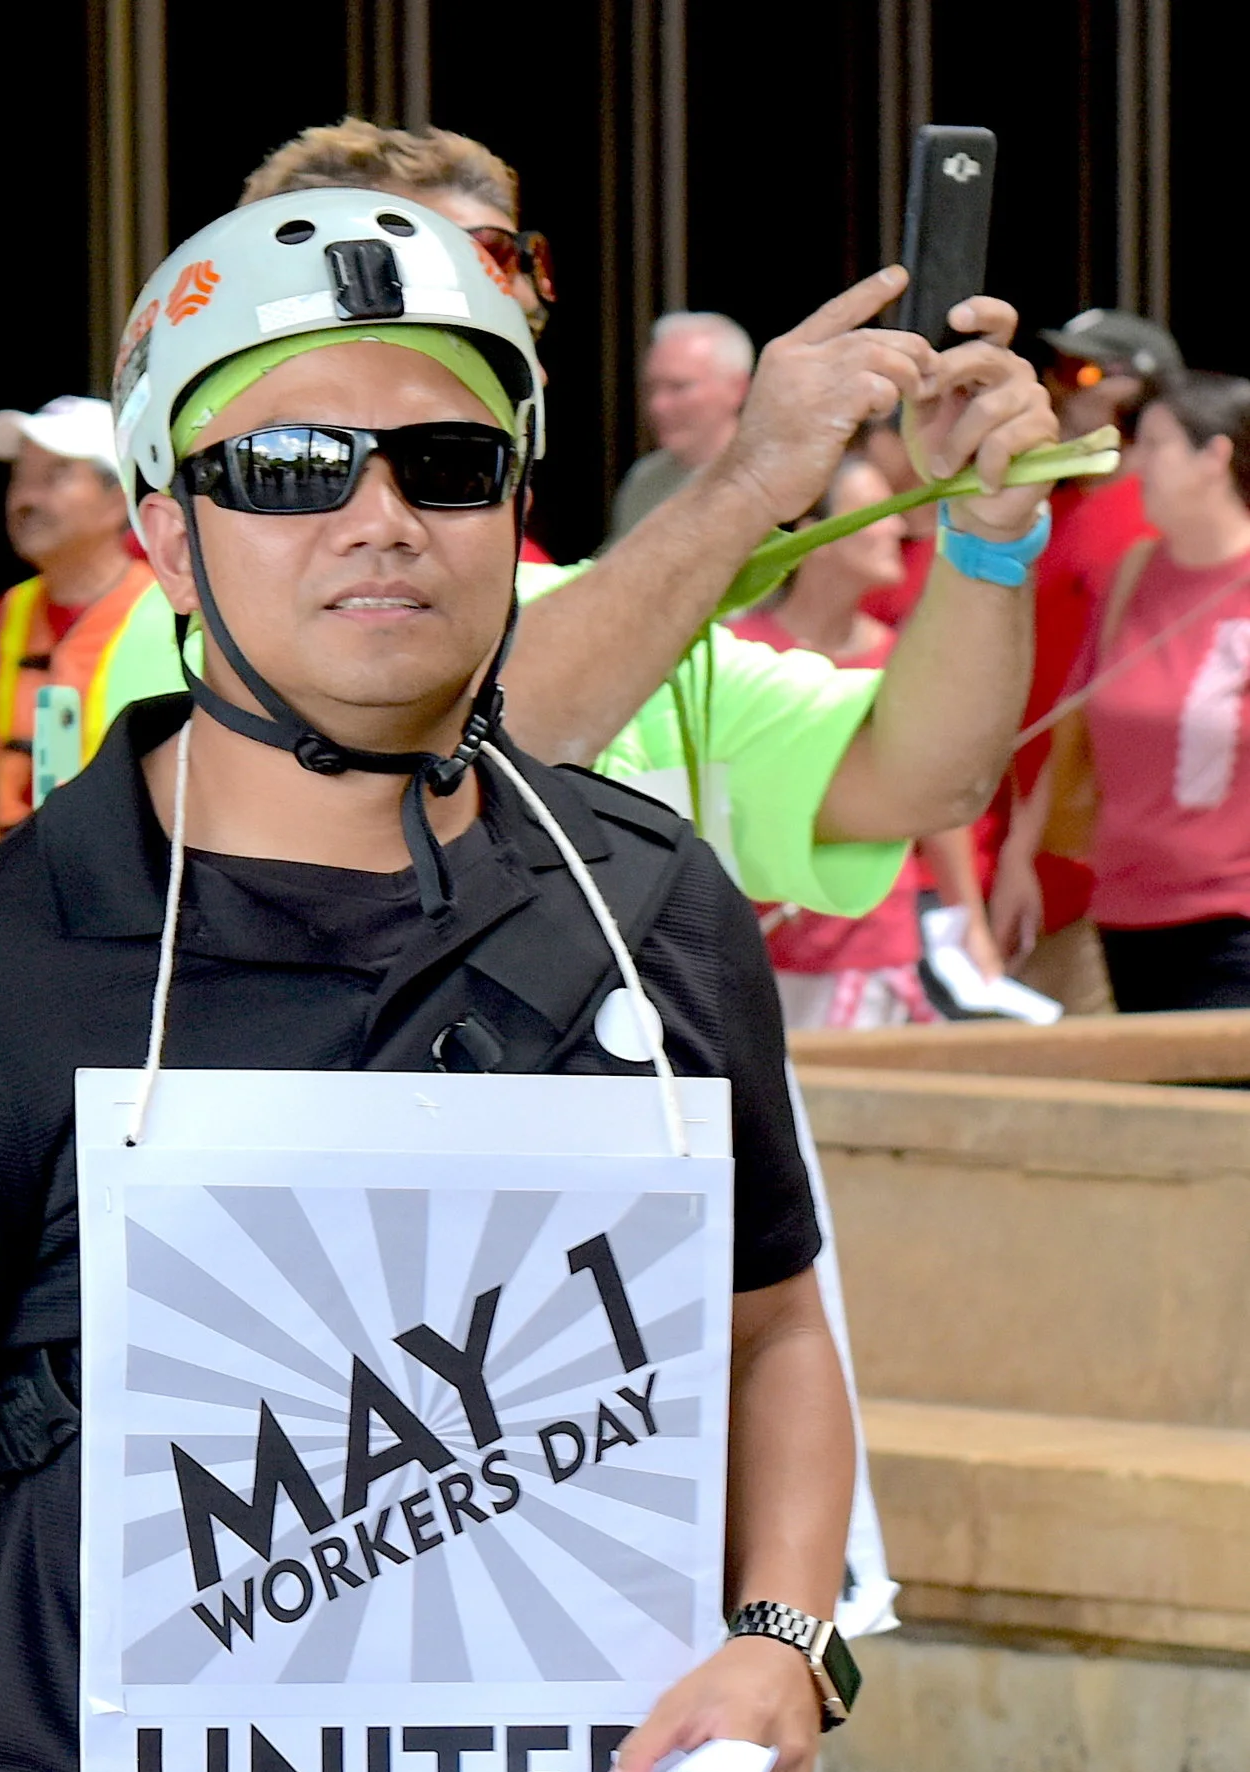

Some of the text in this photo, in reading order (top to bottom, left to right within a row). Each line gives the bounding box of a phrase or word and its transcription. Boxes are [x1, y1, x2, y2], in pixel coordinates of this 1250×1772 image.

[169, 1231, 650, 1594] MAY 1
[189, 1371, 660, 1654] WORKERS DAY
